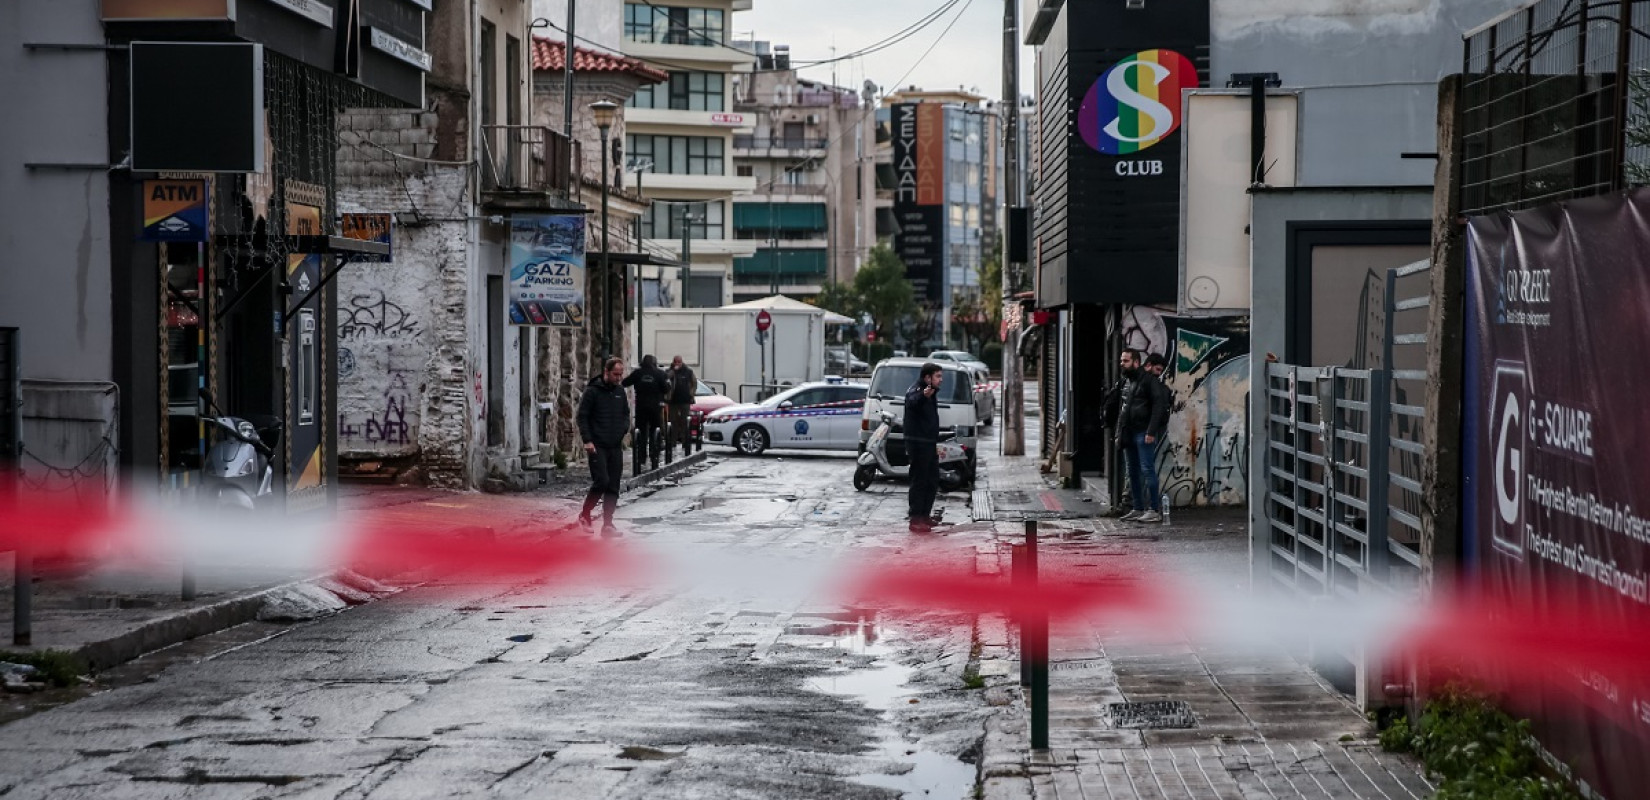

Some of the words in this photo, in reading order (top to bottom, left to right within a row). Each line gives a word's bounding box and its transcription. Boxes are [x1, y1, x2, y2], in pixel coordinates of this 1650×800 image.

[1103, 59, 1174, 143] S
[1115, 160, 1164, 176] CLUB
[151, 185, 197, 201] ATM
[524, 263, 570, 276] GAZI
[1528, 399, 1536, 441] G
[1545, 401, 1593, 456] SQUARE
[1496, 392, 1520, 525] G
[1566, 486, 1589, 519] Rental
[1541, 532, 1563, 565] afest
[1563, 543, 1577, 571] and
